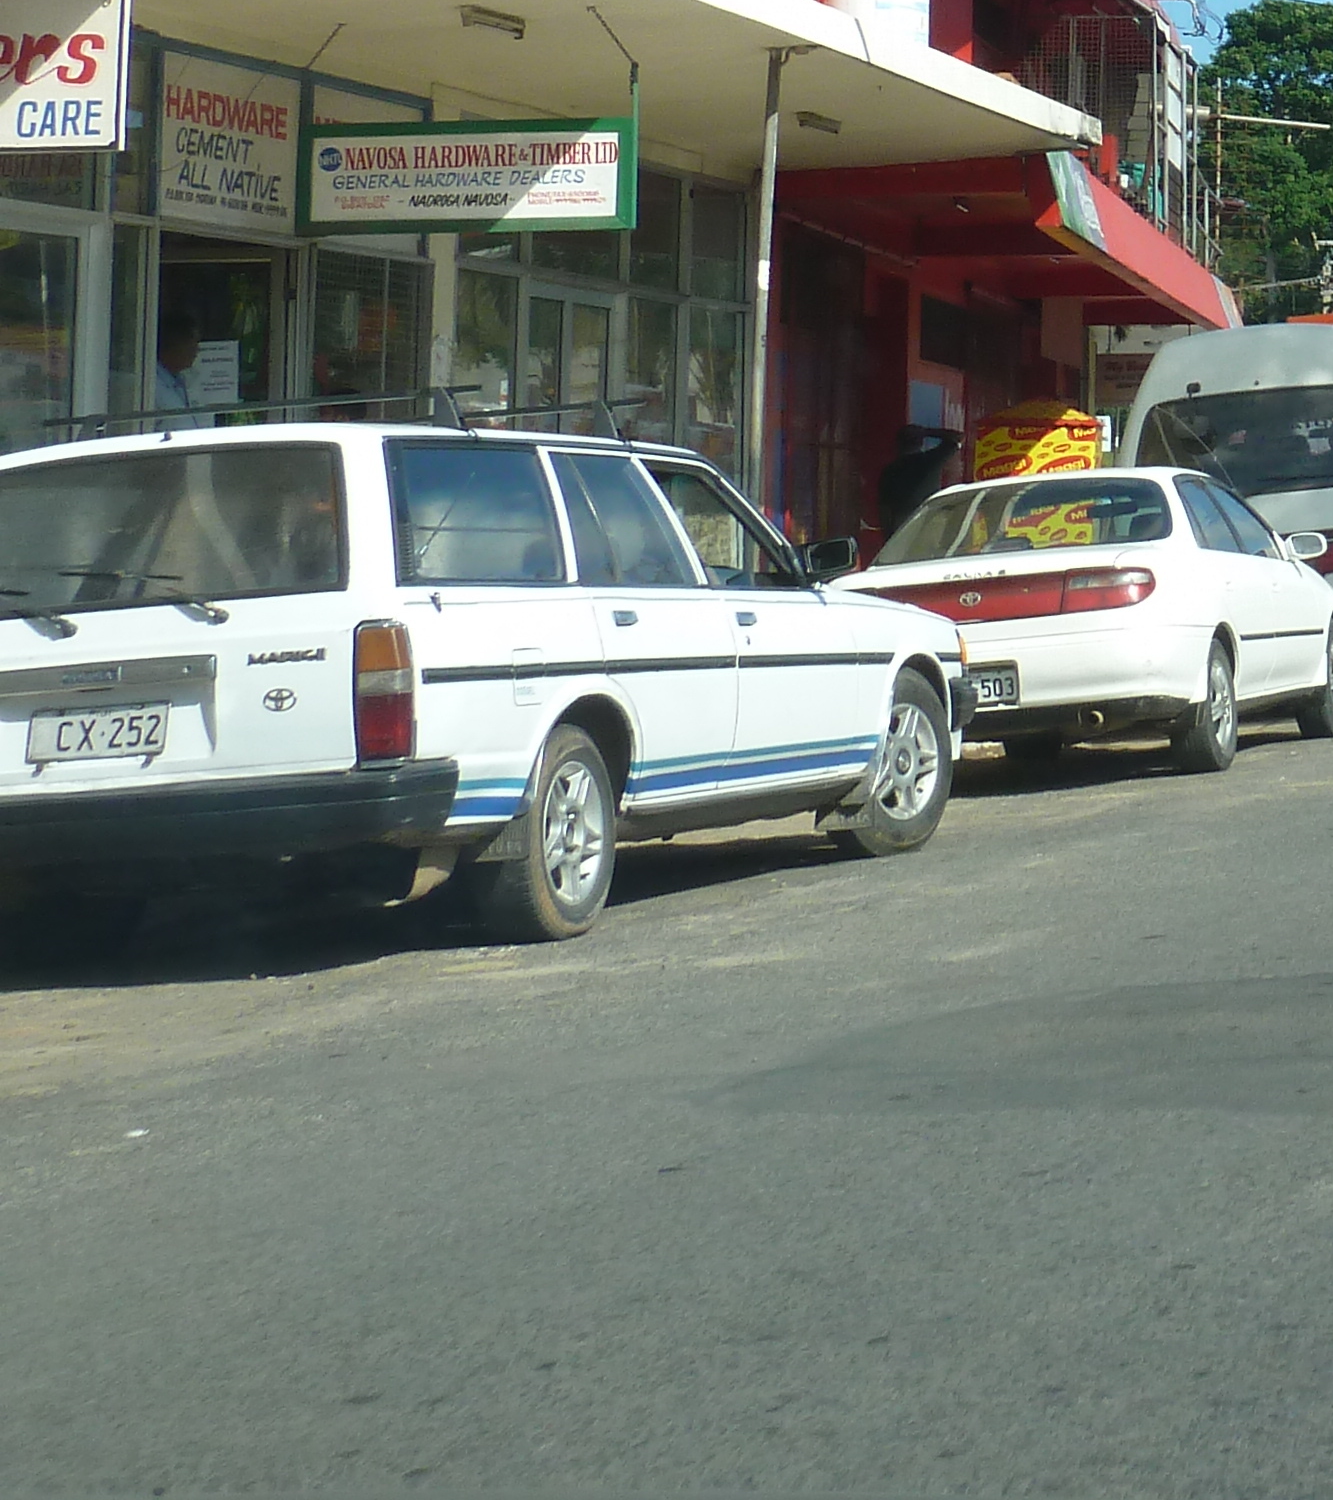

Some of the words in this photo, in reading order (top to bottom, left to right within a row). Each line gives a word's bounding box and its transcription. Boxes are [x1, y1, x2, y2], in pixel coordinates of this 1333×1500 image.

[17, 100, 103, 138] CARE
[166, 84, 288, 140] HARDWARE
[345, 146, 408, 171] NAVOSA
[413, 143, 517, 169] HARDWARE
[519, 148, 528, 161] &
[529, 141, 592, 166] TIMBER
[594, 141, 619, 164] LTD
[178, 160, 211, 191] ALL
[333, 174, 410, 190] GENERAL
[414, 171, 502, 188] HARDWARE
[509, 169, 586, 186] DEALERS
[983, 458, 1027, 477] Maggi
